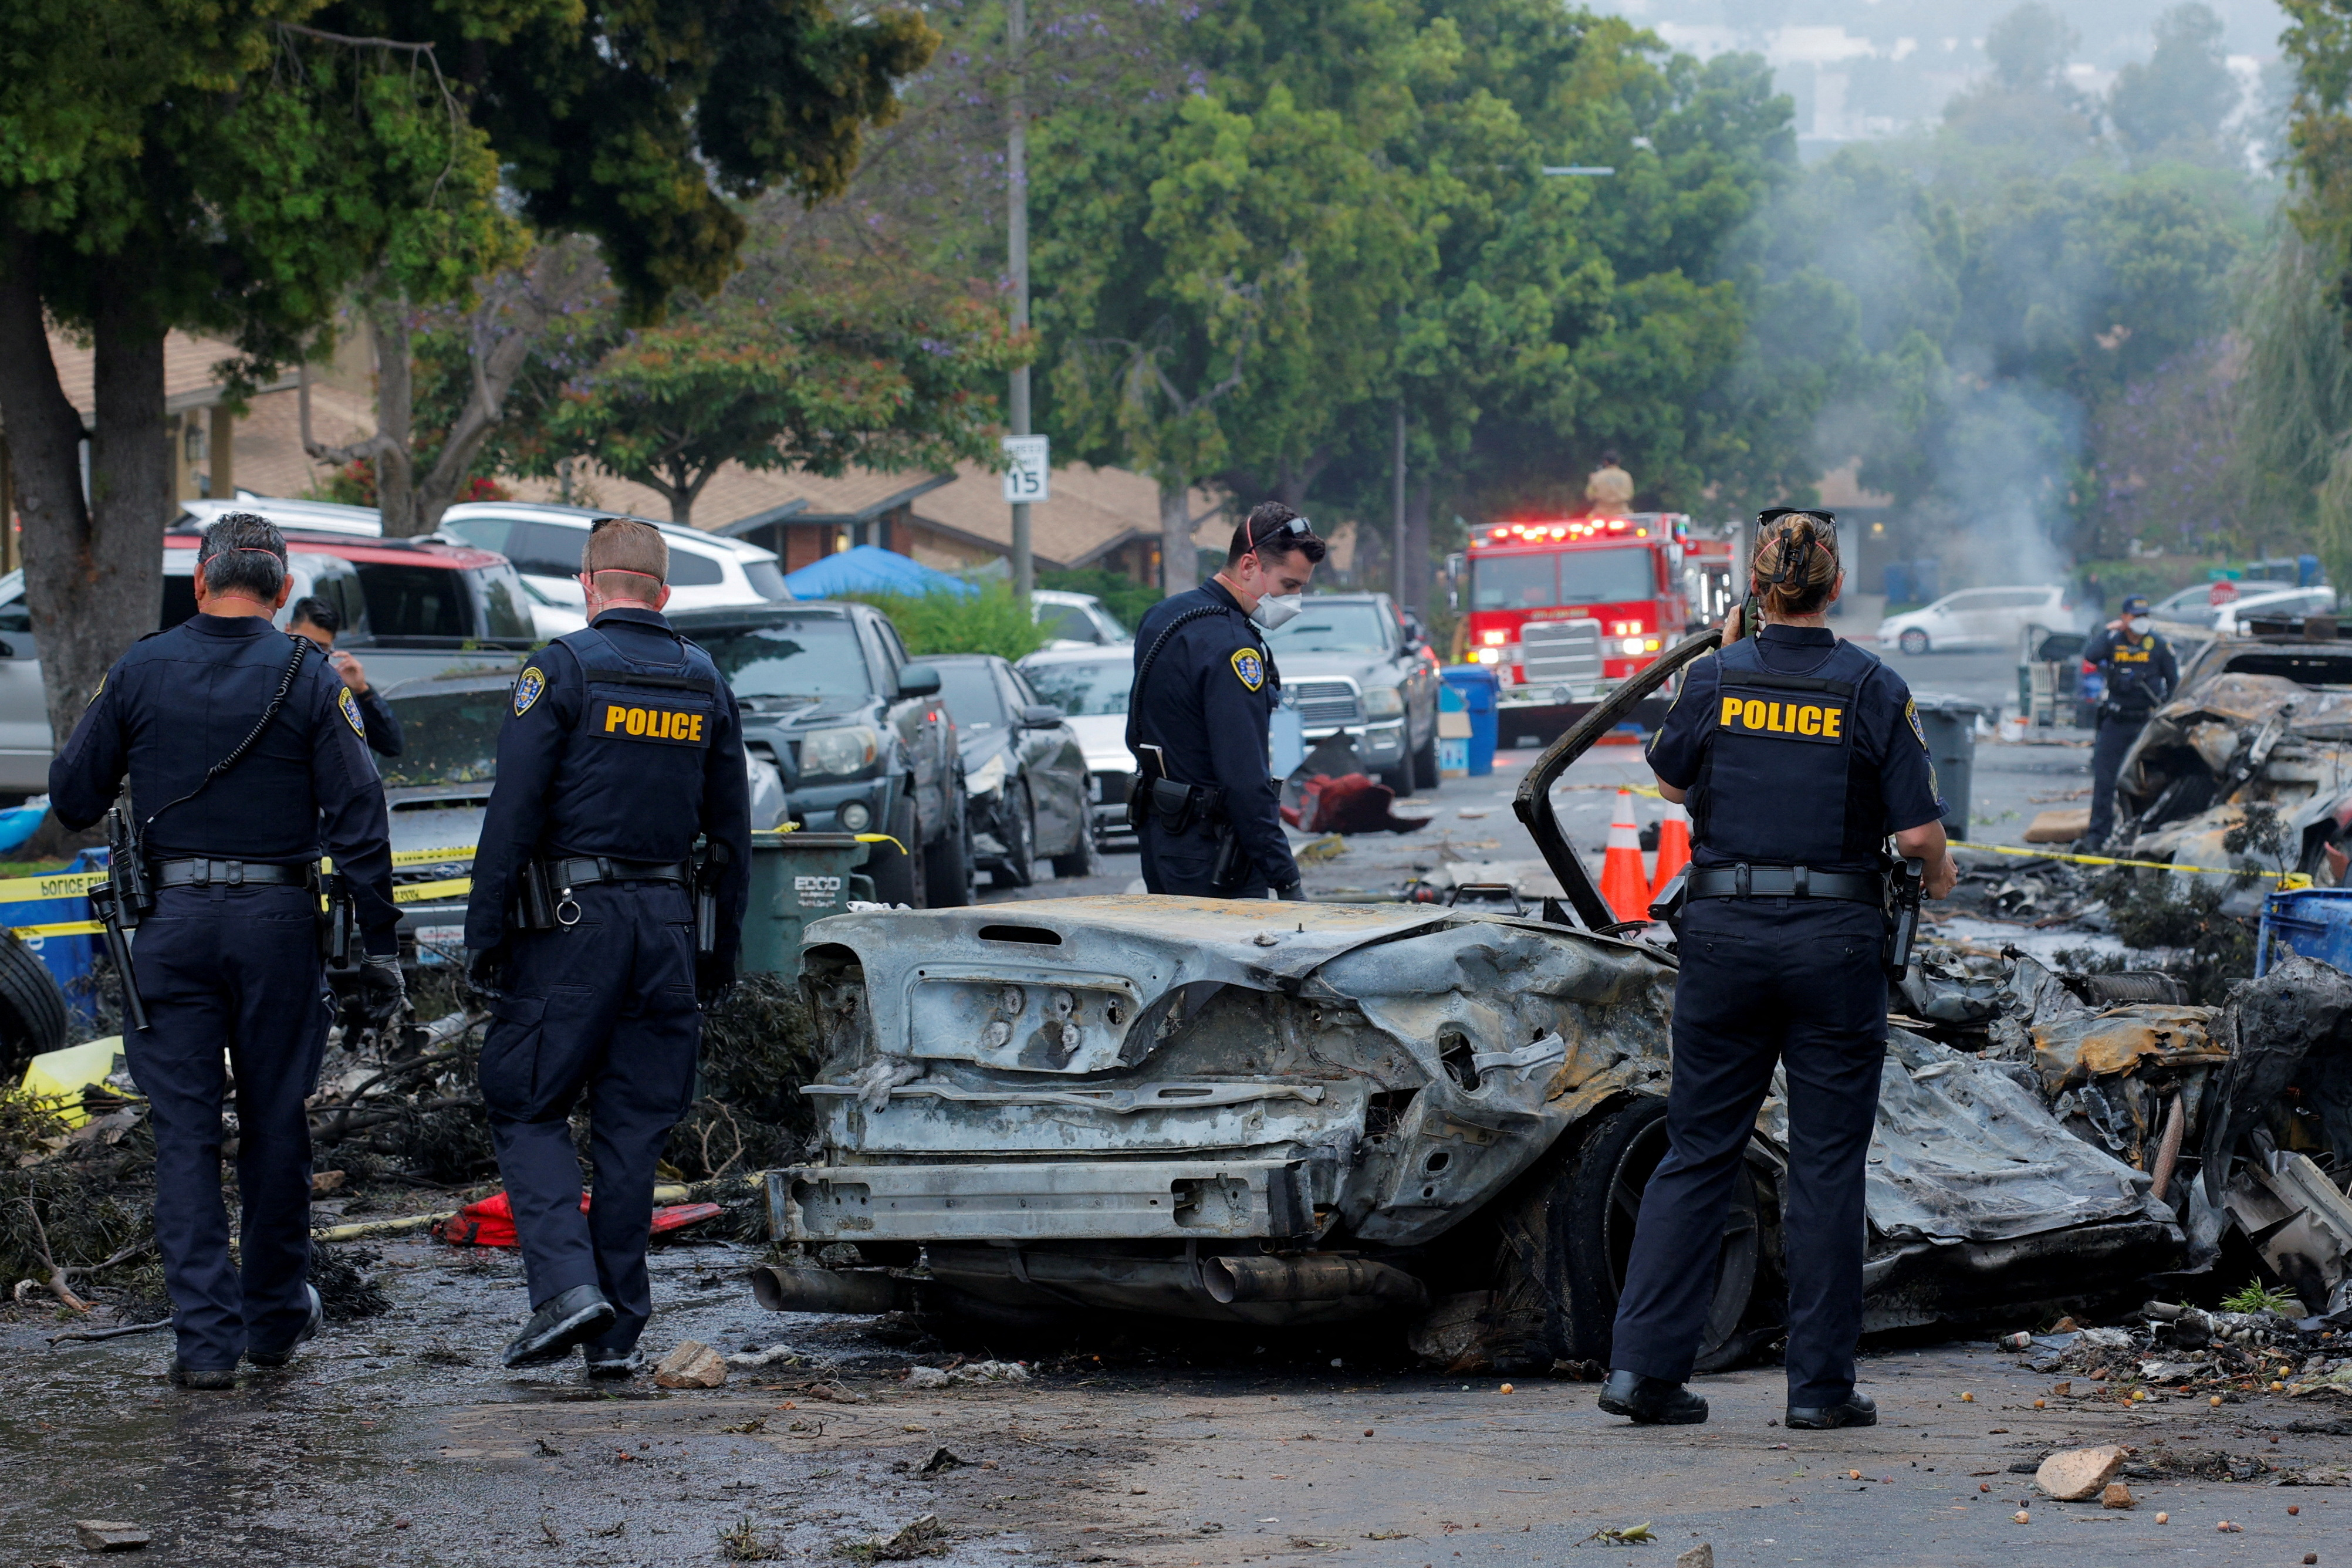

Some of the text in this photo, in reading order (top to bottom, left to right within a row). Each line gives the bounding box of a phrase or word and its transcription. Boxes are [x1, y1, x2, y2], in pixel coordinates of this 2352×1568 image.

[1011, 471, 1040, 494] 15
[605, 705, 703, 741] POLICE
[1720, 697, 1842, 738] POLICE
[795, 876, 841, 890] EDCO
